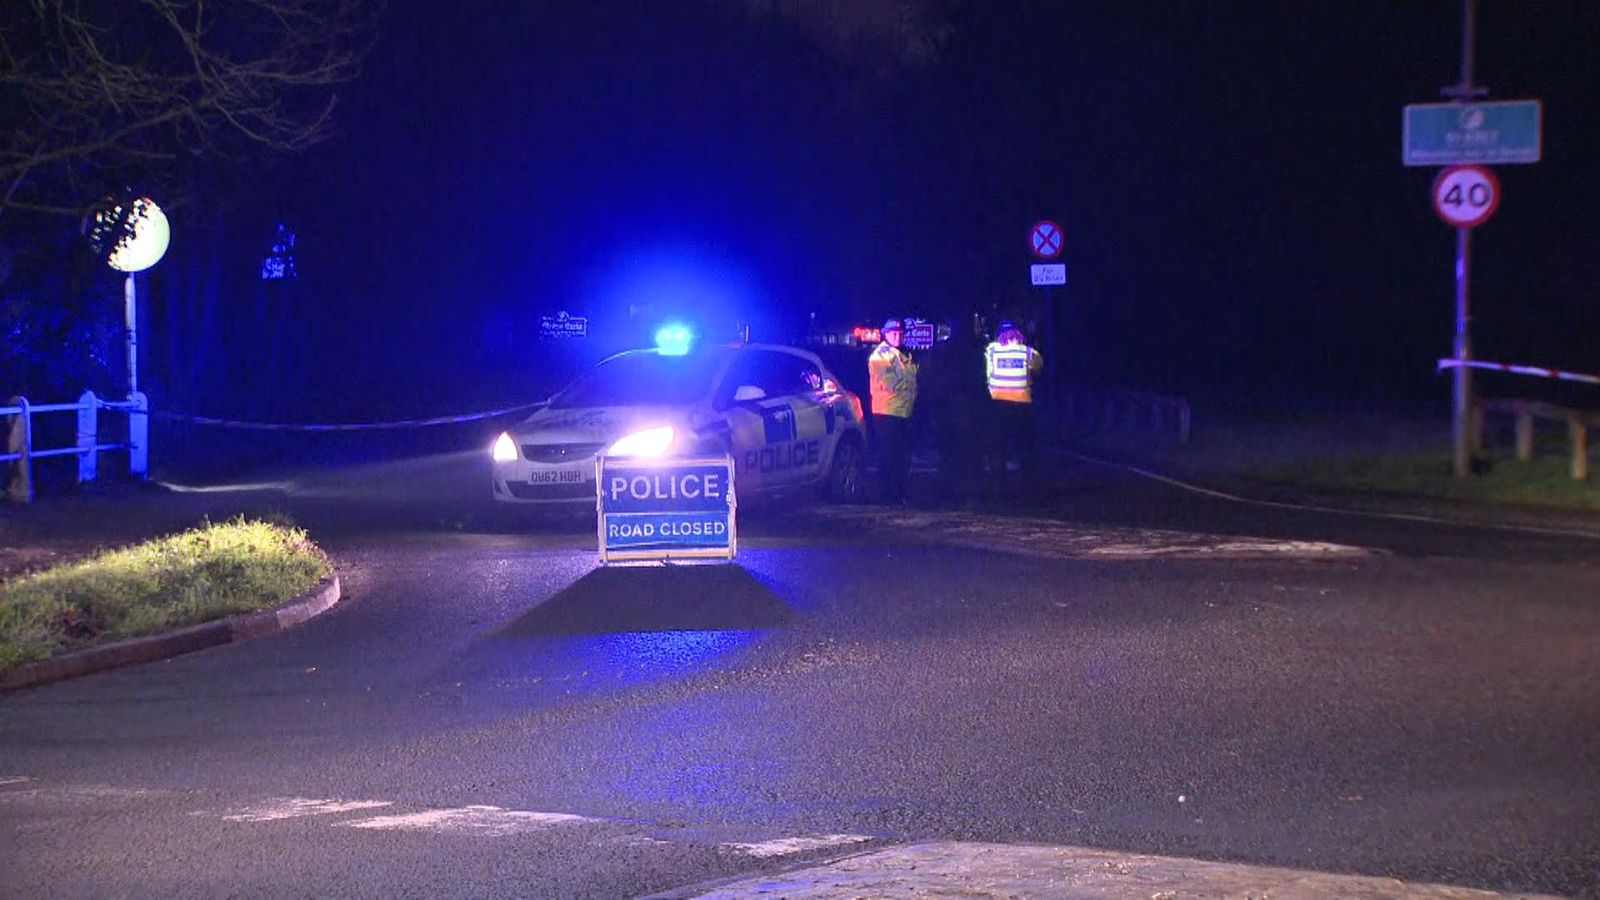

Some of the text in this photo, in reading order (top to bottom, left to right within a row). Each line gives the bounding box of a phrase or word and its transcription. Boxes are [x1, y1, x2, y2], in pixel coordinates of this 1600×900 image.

[1444, 183, 1489, 207] 40
[745, 440, 819, 473] POLICE
[611, 474, 720, 500] POLICE
[609, 522, 726, 538] ROAD CLOSED
